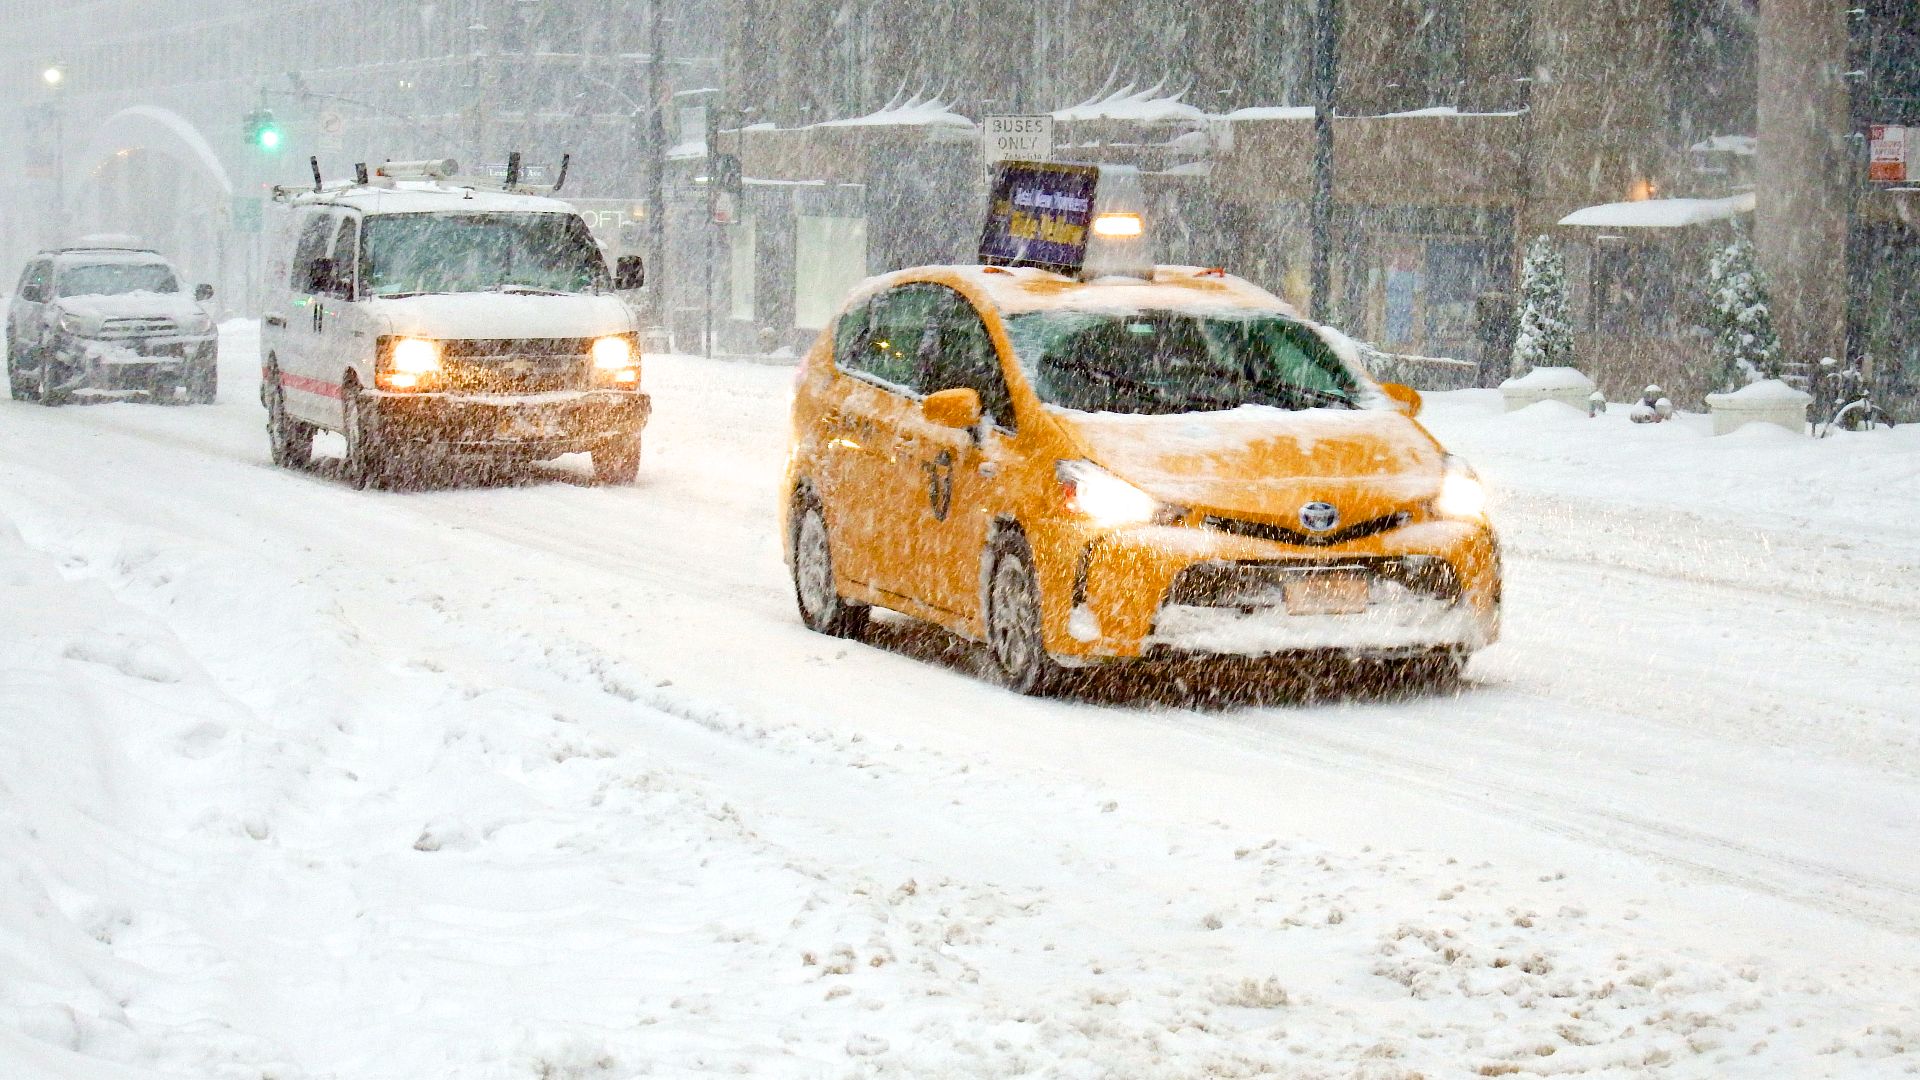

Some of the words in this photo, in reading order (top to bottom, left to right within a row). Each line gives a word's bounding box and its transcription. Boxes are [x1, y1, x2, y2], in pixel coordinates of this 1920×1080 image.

[993, 120, 1042, 132] BUSES
[998, 137, 1037, 149] ONLY
[529, 169, 542, 177] Ave
[580, 210, 625, 228] OFT
